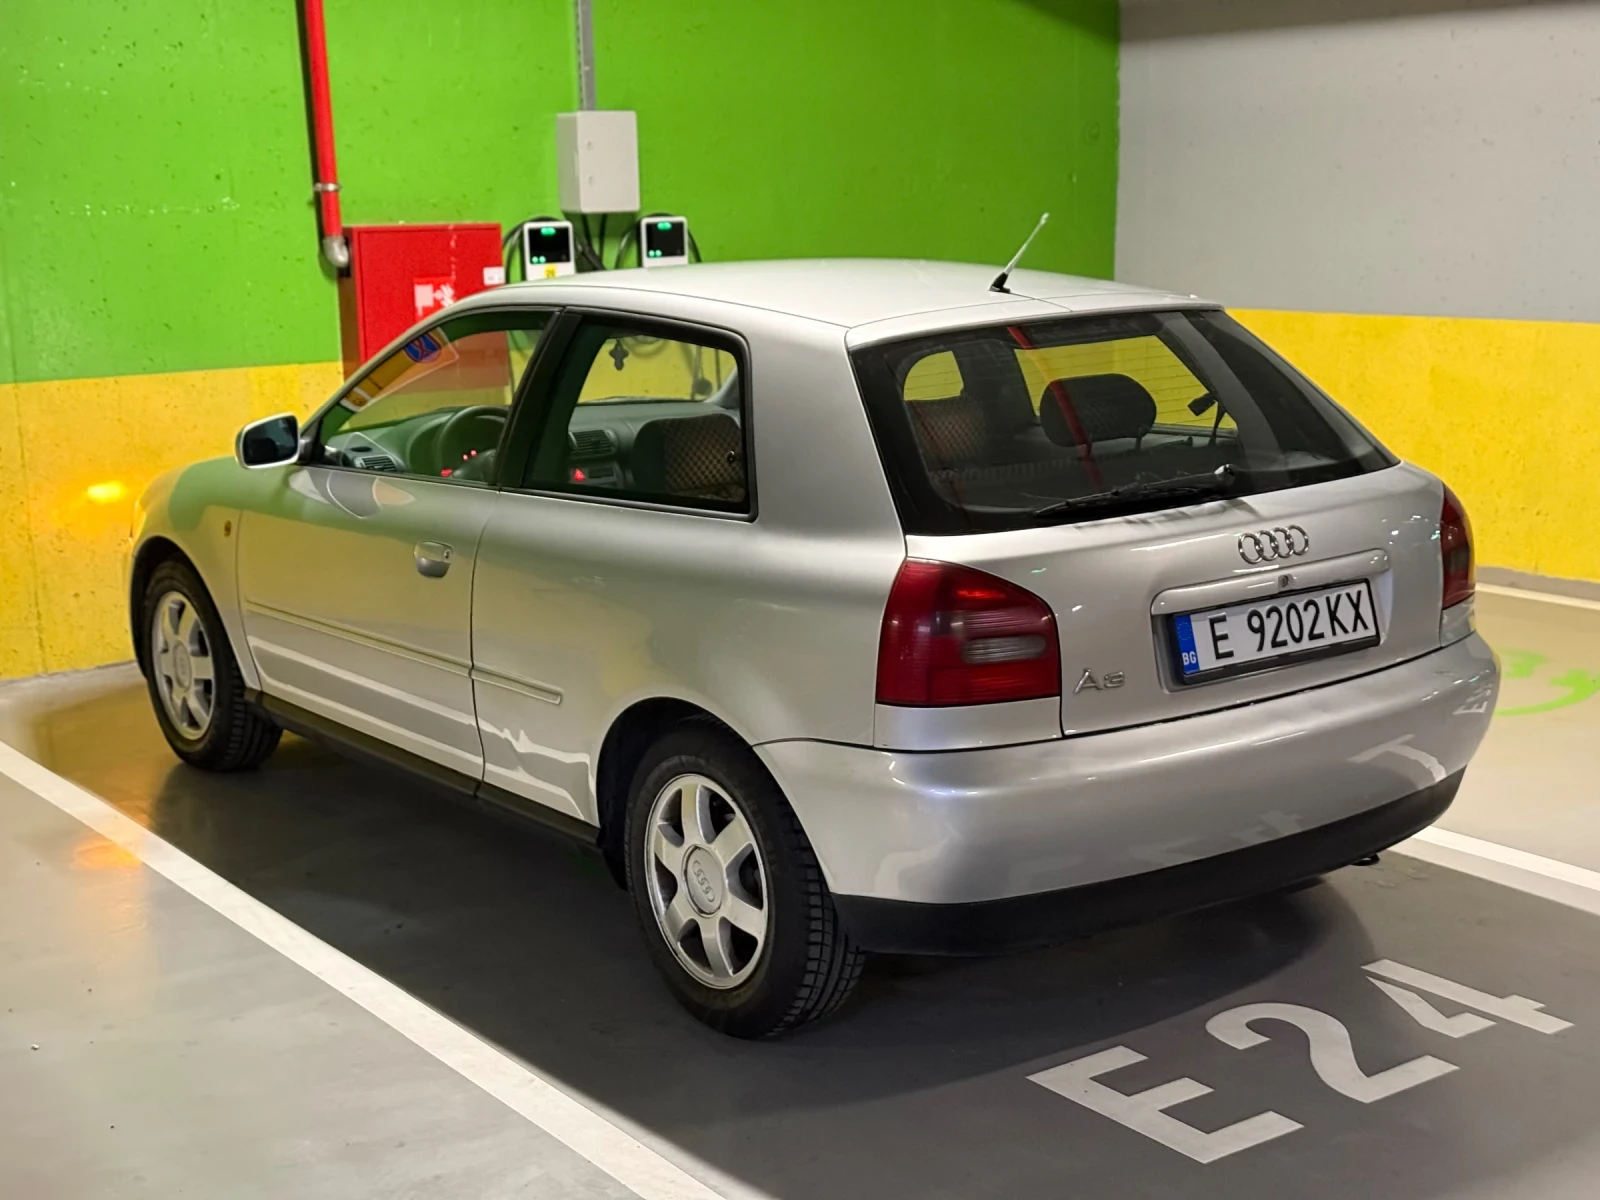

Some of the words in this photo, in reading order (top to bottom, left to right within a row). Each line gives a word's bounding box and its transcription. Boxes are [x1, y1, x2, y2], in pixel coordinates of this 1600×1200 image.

[1181, 650, 1198, 666] BG
[1208, 612, 1235, 660] E
[1025, 958, 1576, 1164] E24
